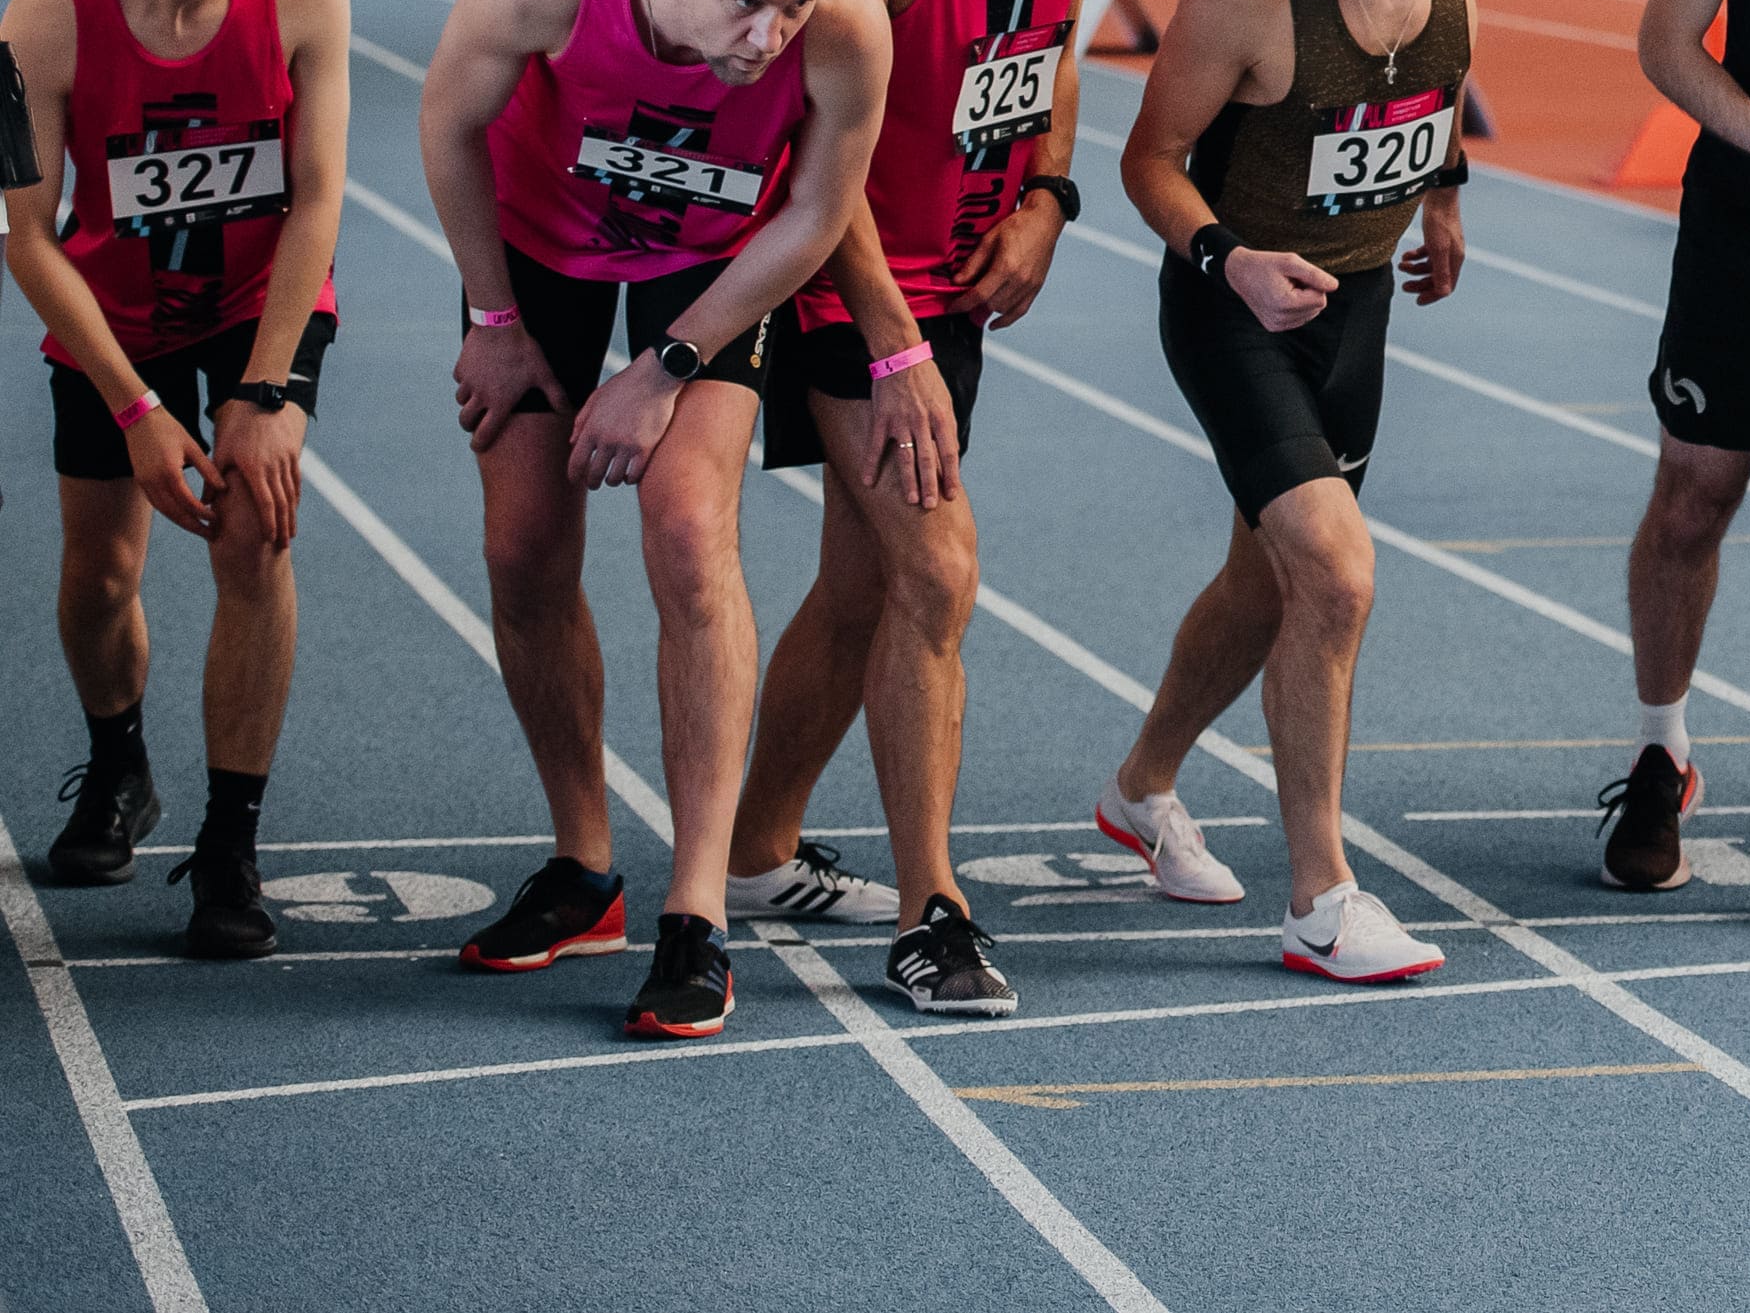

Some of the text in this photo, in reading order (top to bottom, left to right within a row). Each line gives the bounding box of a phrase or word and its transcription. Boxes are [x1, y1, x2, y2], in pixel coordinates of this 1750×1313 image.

[969, 55, 1046, 122] 325
[134, 146, 256, 208] 327
[605, 146, 727, 195] 321
[1333, 121, 1435, 187] 320
